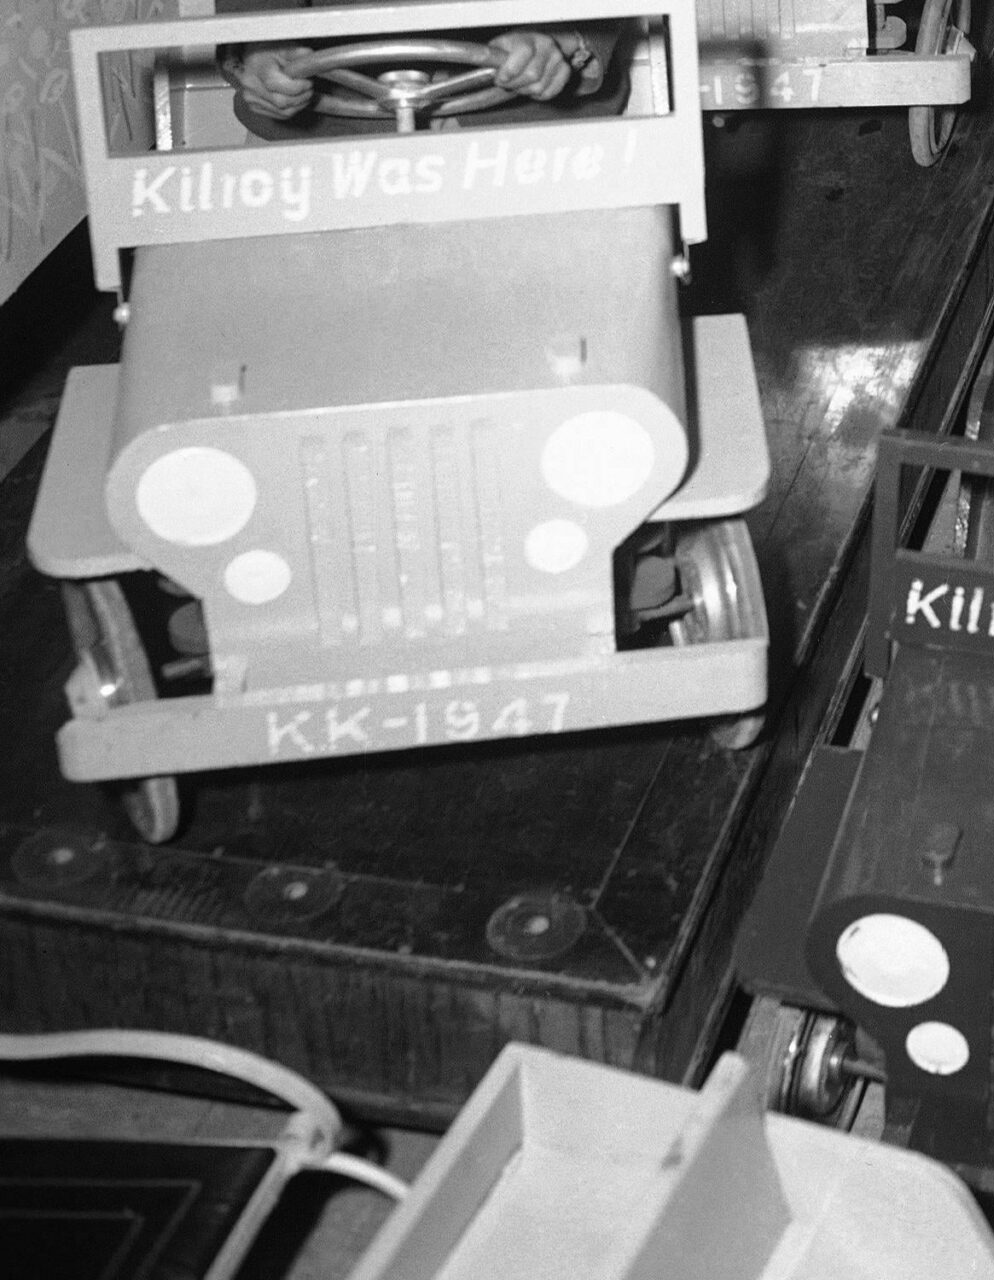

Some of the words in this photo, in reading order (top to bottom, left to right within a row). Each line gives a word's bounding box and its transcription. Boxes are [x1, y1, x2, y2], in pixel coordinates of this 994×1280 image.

[131, 160, 313, 222] Kilroy
[330, 147, 446, 200] Was
[266, 692, 570, 757] KK-1947
